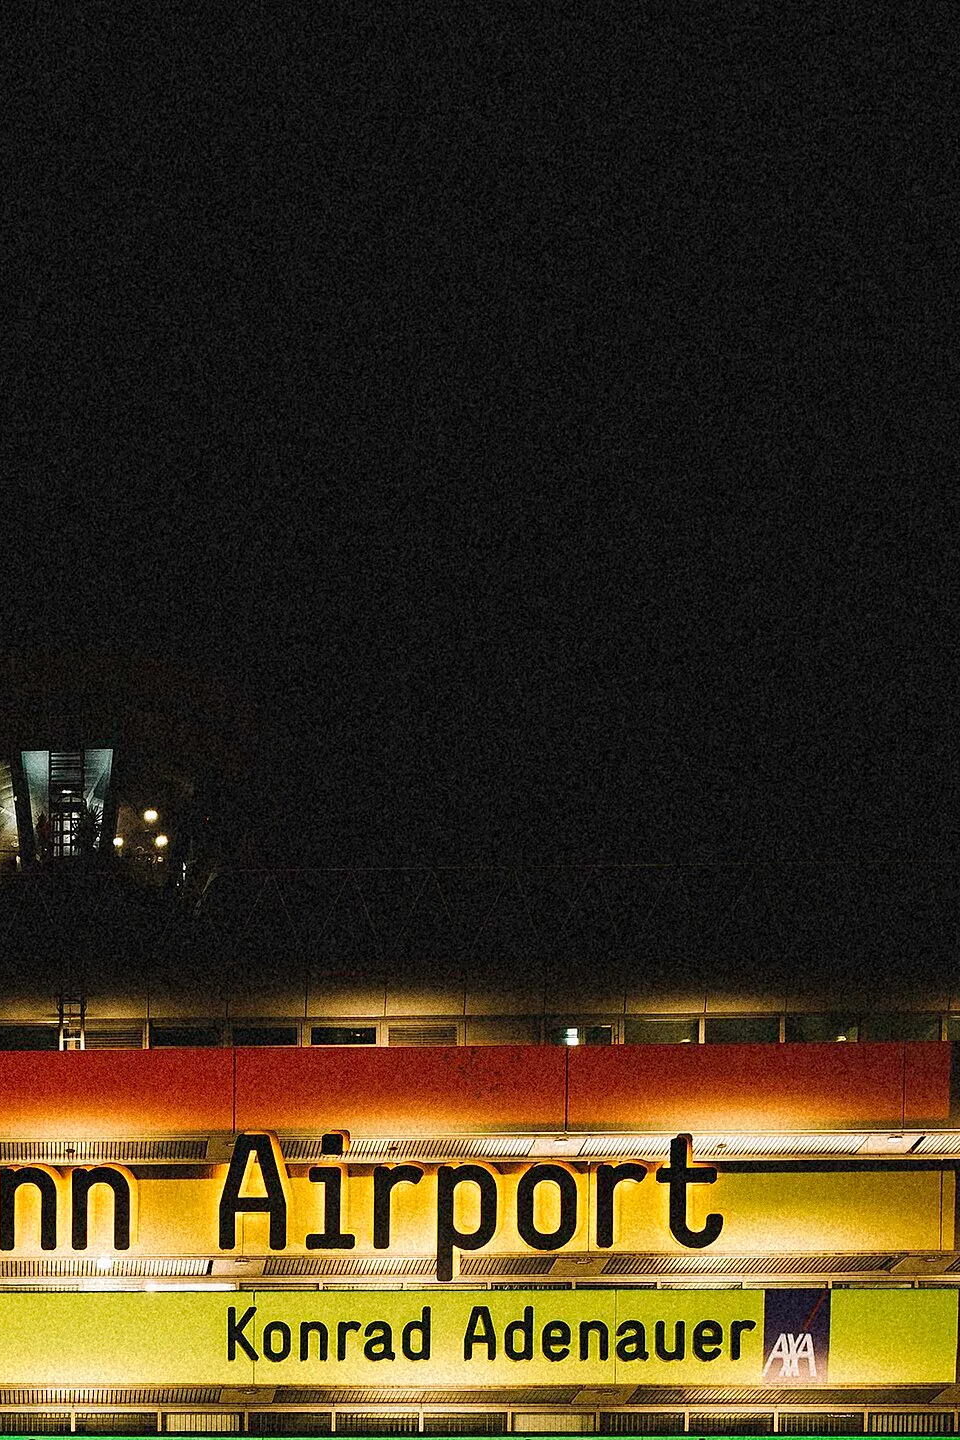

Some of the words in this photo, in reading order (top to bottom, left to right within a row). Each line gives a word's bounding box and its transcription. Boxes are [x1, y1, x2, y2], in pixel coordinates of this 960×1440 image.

[218, 1132, 725, 1282] Airport
[227, 1305, 432, 1363] Konrad
[463, 1305, 757, 1363] Adenauer
[762, 1333, 818, 1378] AXA
